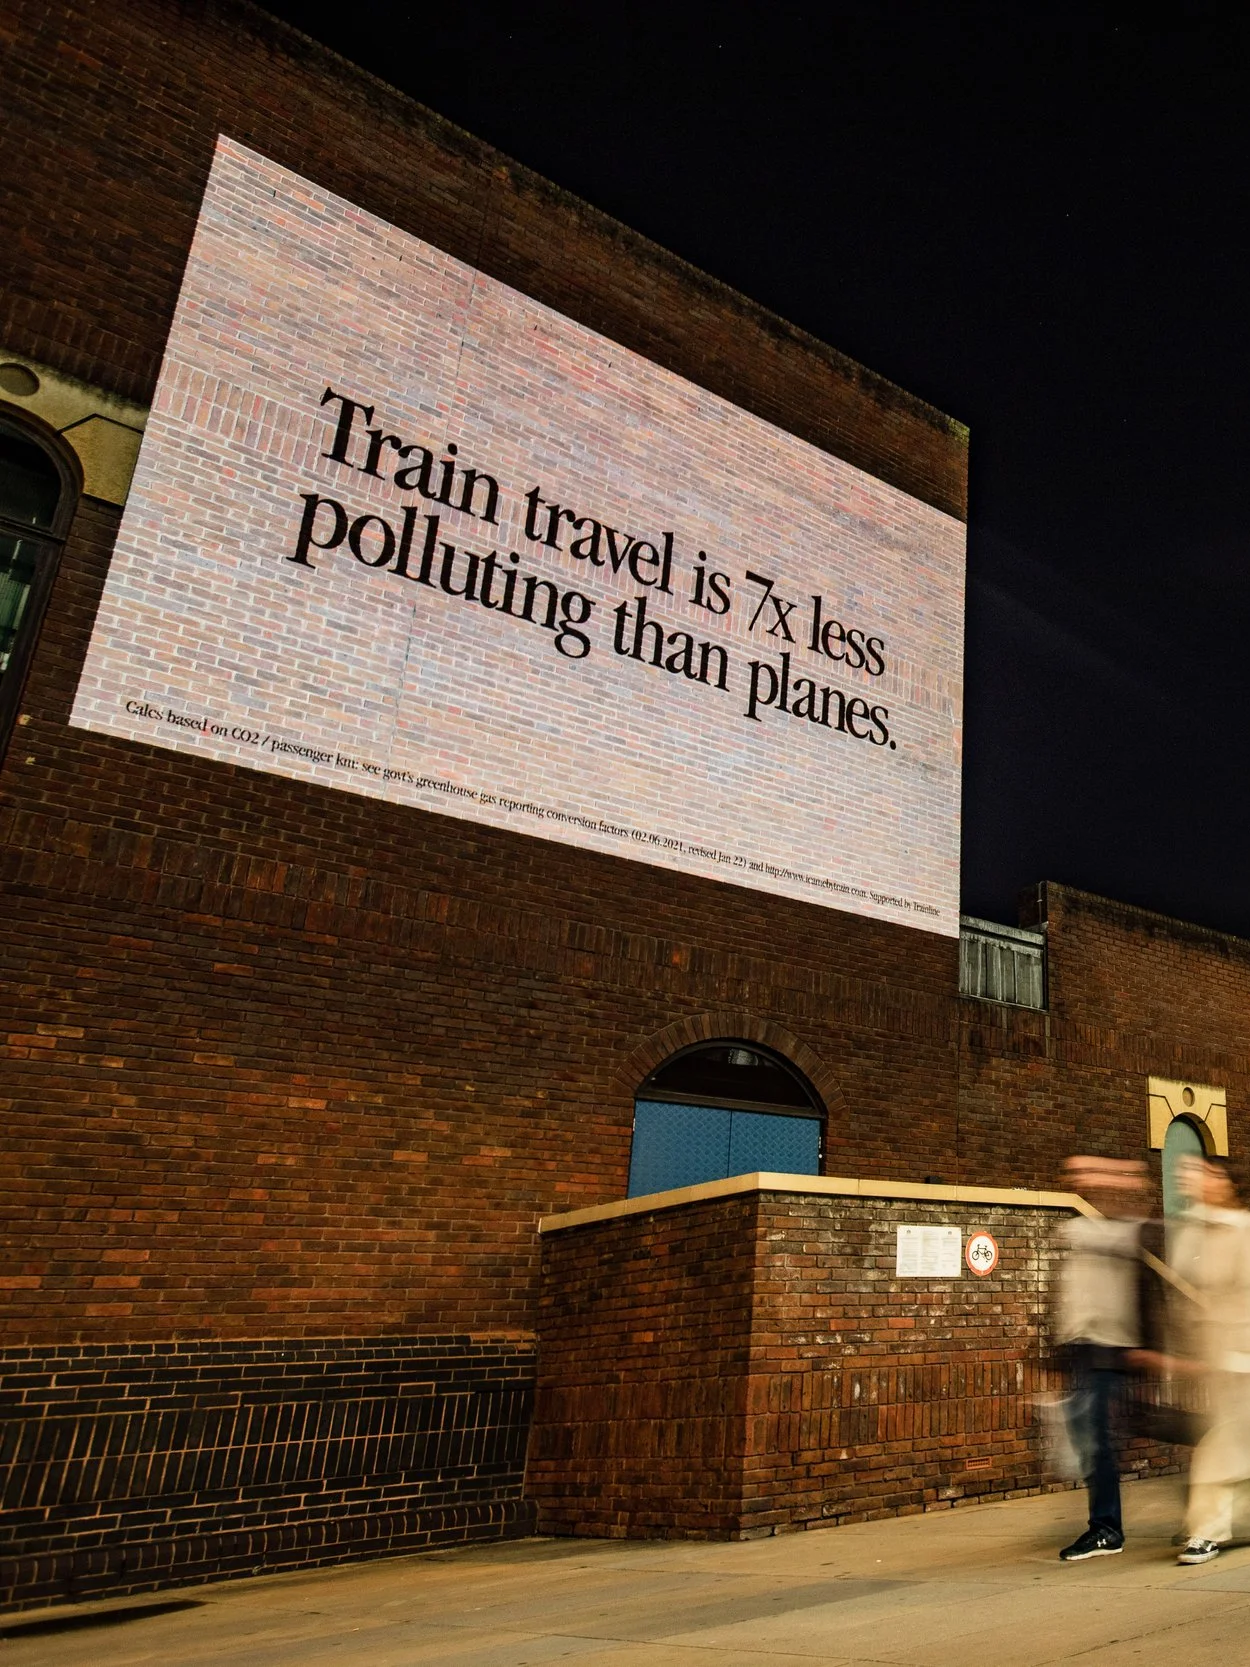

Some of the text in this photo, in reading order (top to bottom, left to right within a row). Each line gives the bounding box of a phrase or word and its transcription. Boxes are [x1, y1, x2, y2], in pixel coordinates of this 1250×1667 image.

[286, 493, 897, 751] polluting than planes.
[320, 386, 885, 677] Train travel is 7x less
[126, 700, 164, 721] Calcs
[167, 709, 208, 732] based
[210, 723, 228, 737] on
[231, 727, 259, 745] CO2
[261, 735, 270, 747] /
[271, 739, 334, 764] passenger
[335, 752, 359, 770] km:
[361, 761, 382, 776] see
[383, 768, 415, 783] govt's
[415, 777, 479, 799] greenhouse
[480, 792, 497, 804] gas
[499, 797, 545, 819] reporting
[546, 809, 597, 830] conversion
[599, 820, 629, 838] factors
[631, 831, 687, 854] (02.06.2021,
[688, 844, 717, 860] revised
[717, 851, 731, 864] Jan
[733, 855, 747, 868] 22)
[748, 861, 764, 872] and
[869, 891, 903, 908] Supported
[904, 898, 911, 912] by
[913, 901, 941, 917] Trainline
